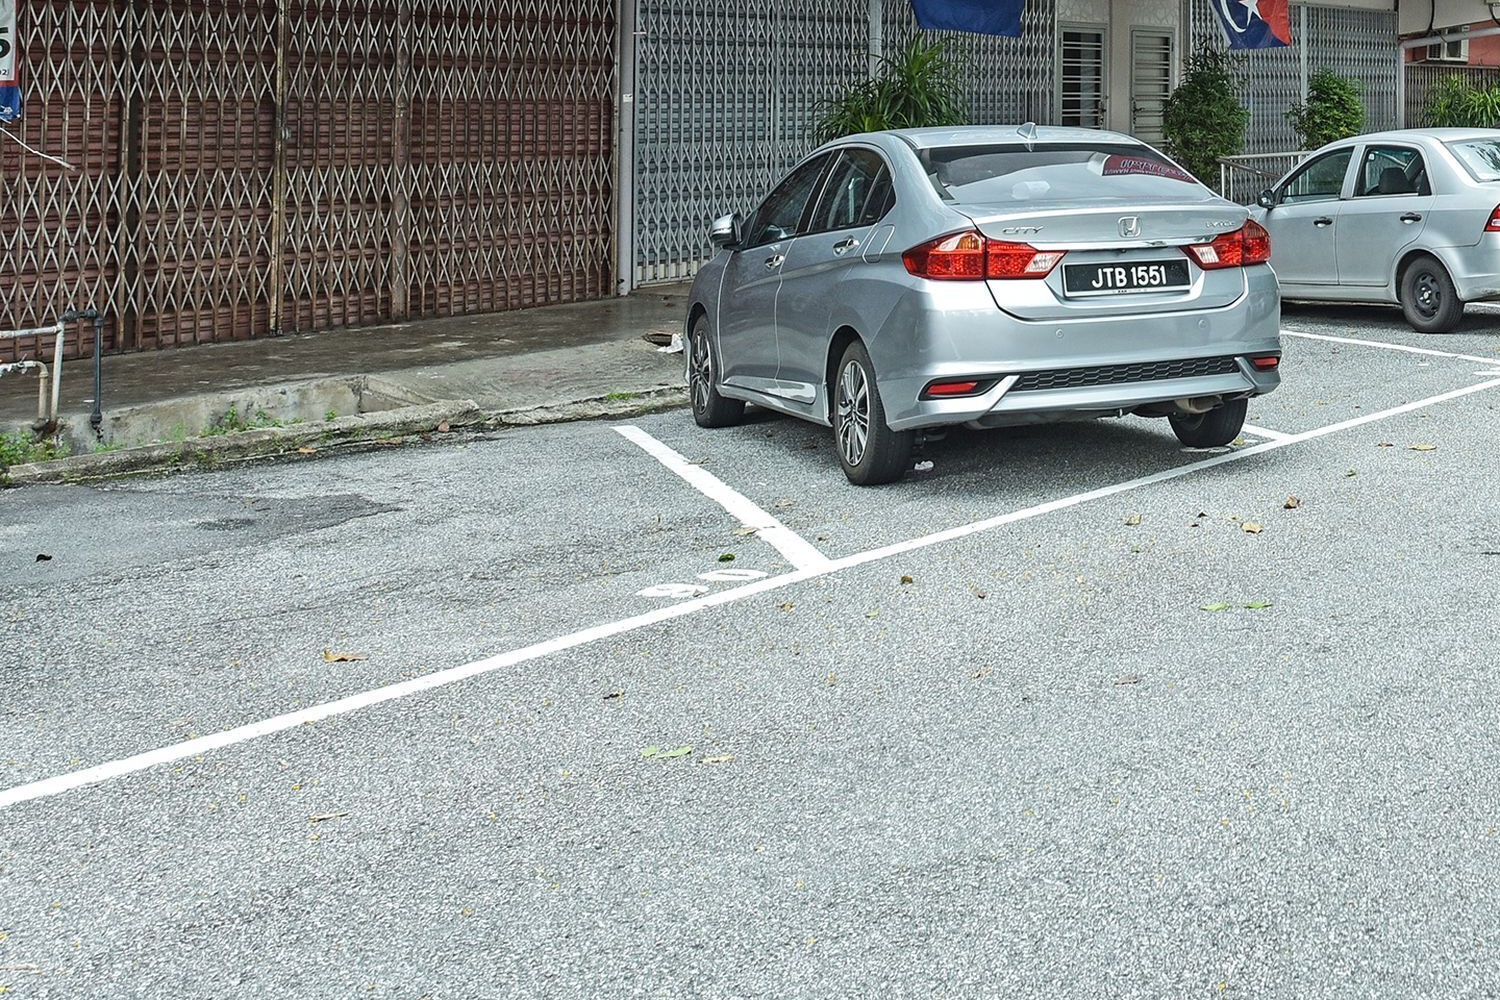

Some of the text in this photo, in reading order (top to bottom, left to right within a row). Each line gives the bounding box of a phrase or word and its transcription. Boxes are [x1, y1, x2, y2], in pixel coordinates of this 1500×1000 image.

[1003, 225, 1044, 234] CITY
[1091, 265, 1167, 288] JTB 1551
